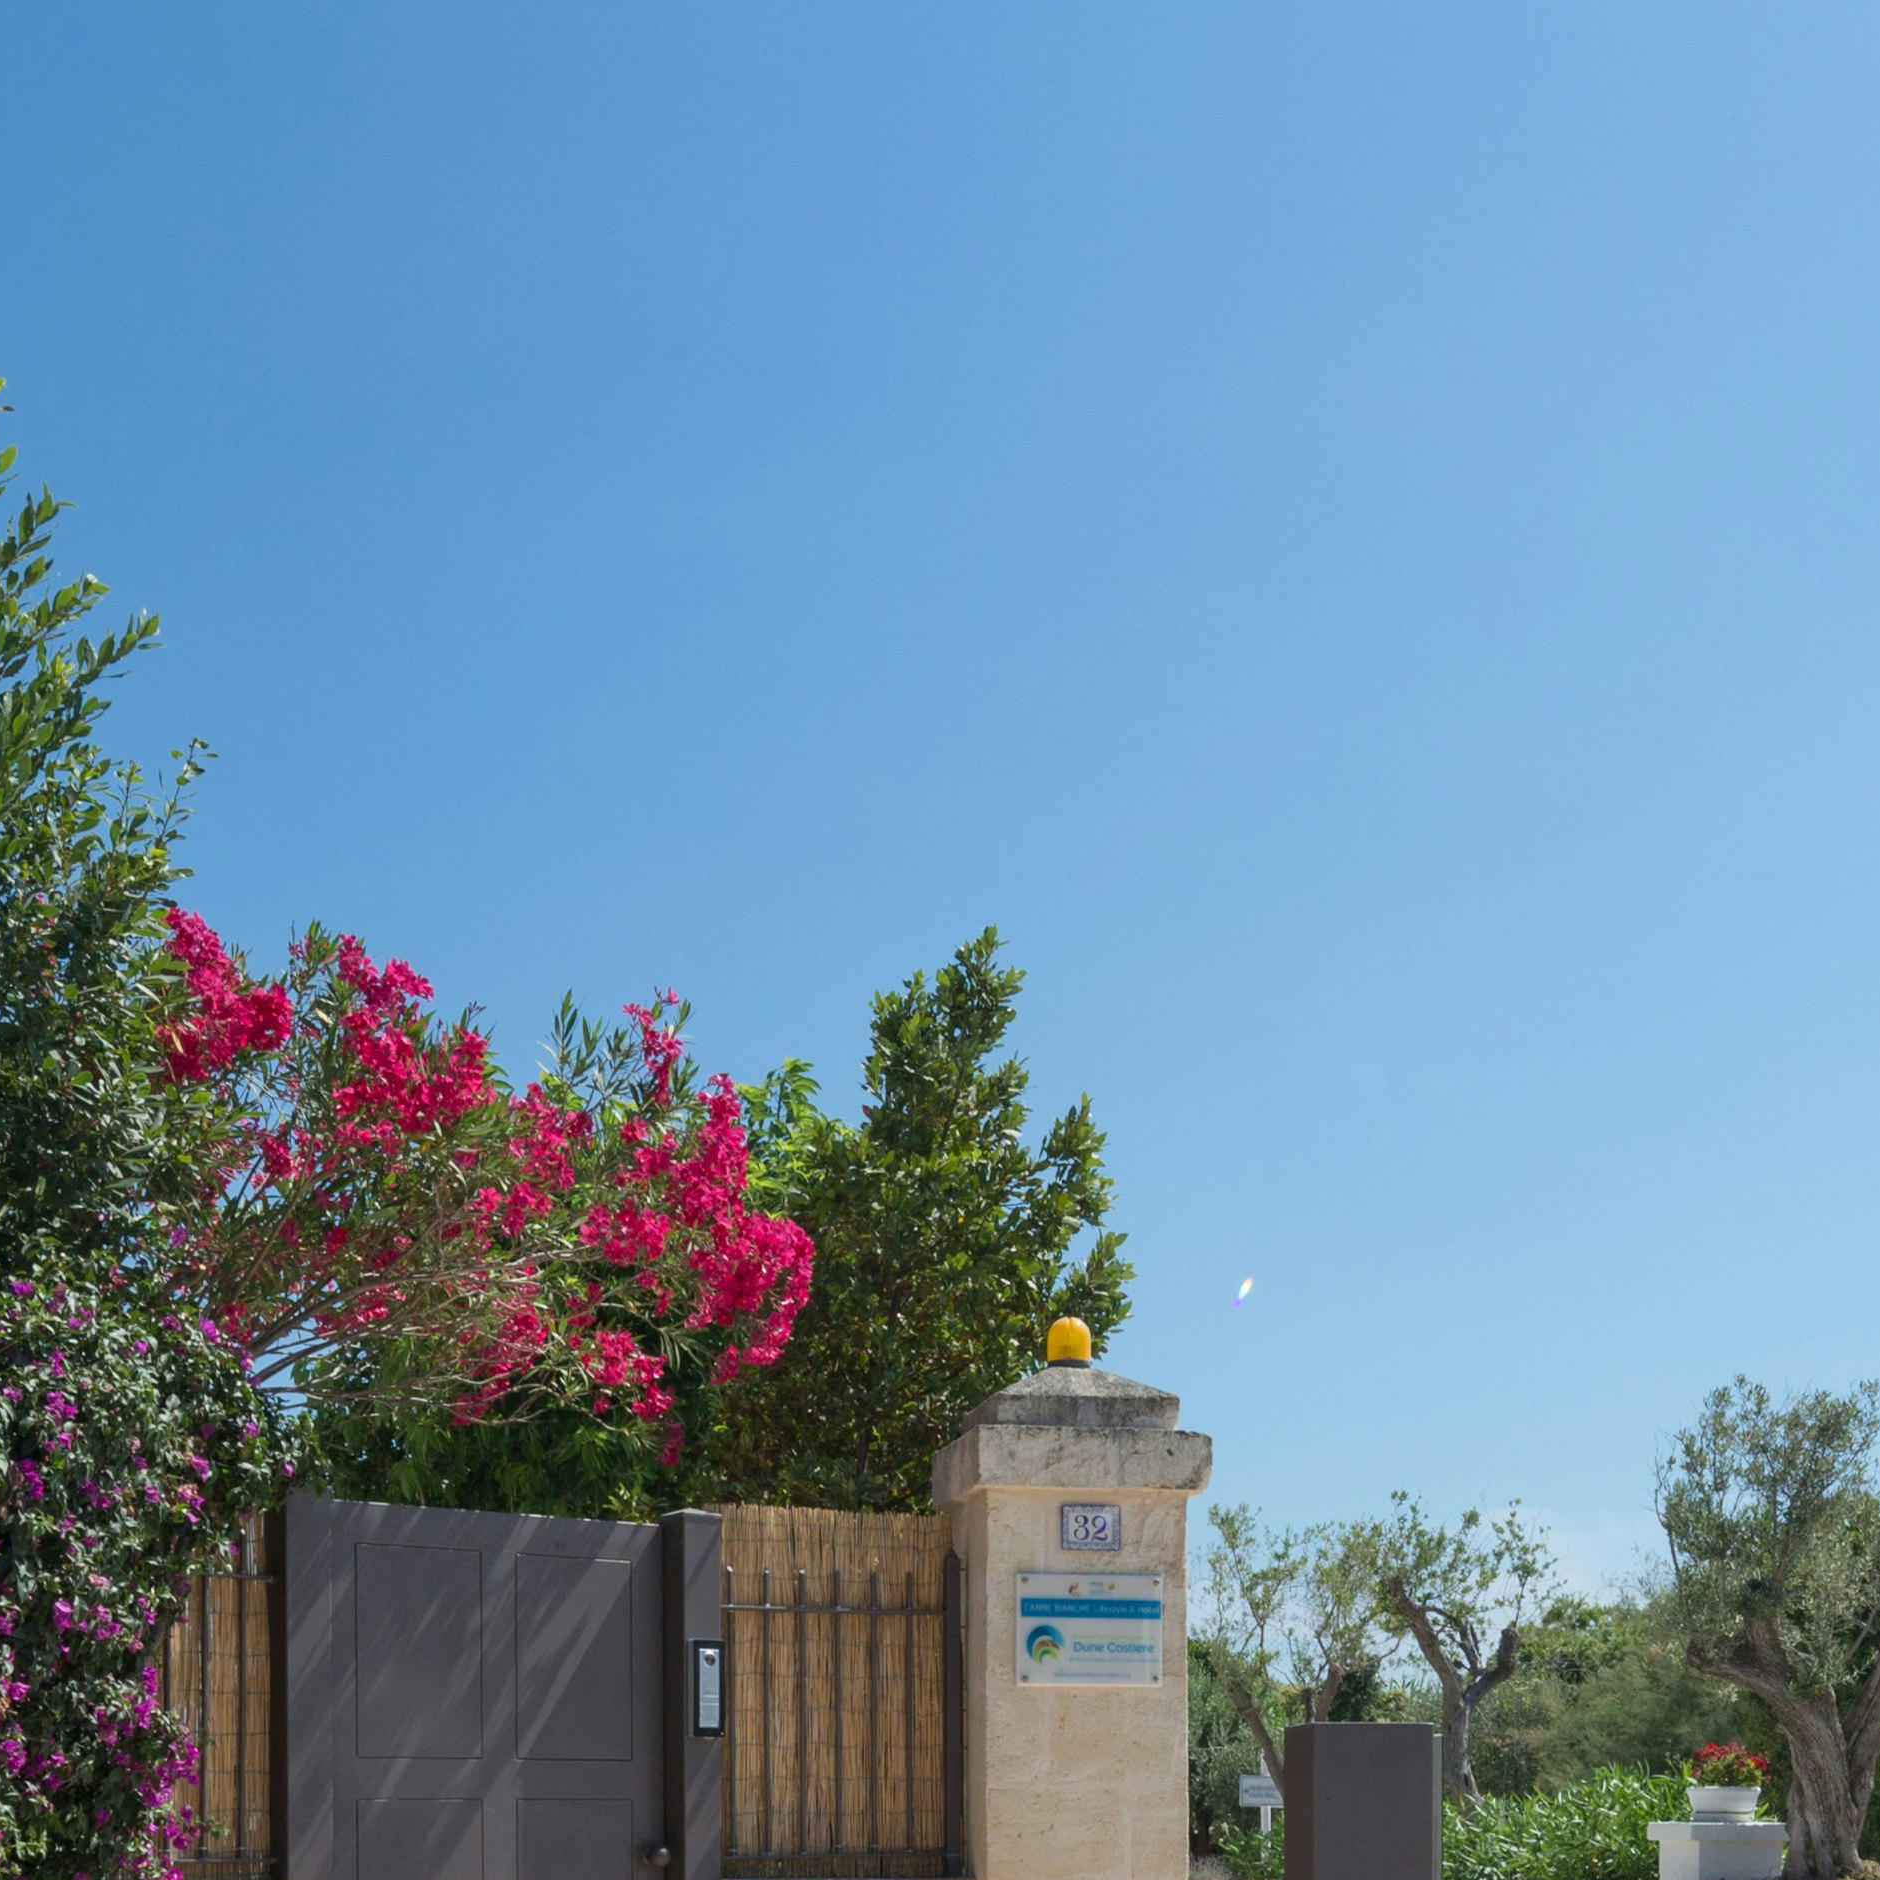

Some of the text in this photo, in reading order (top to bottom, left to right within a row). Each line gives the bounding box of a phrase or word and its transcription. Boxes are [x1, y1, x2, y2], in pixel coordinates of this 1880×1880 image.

[1073, 1514, 1109, 1542] 32
[1024, 1603, 1051, 1612] CANNE
[1054, 1603, 1090, 1613] BIANCHE
[1094, 1604, 1128, 1615] Lifestyle
[1137, 1605, 1160, 1615] Hotel
[1073, 1641, 1155, 1654] Dune Costiere
